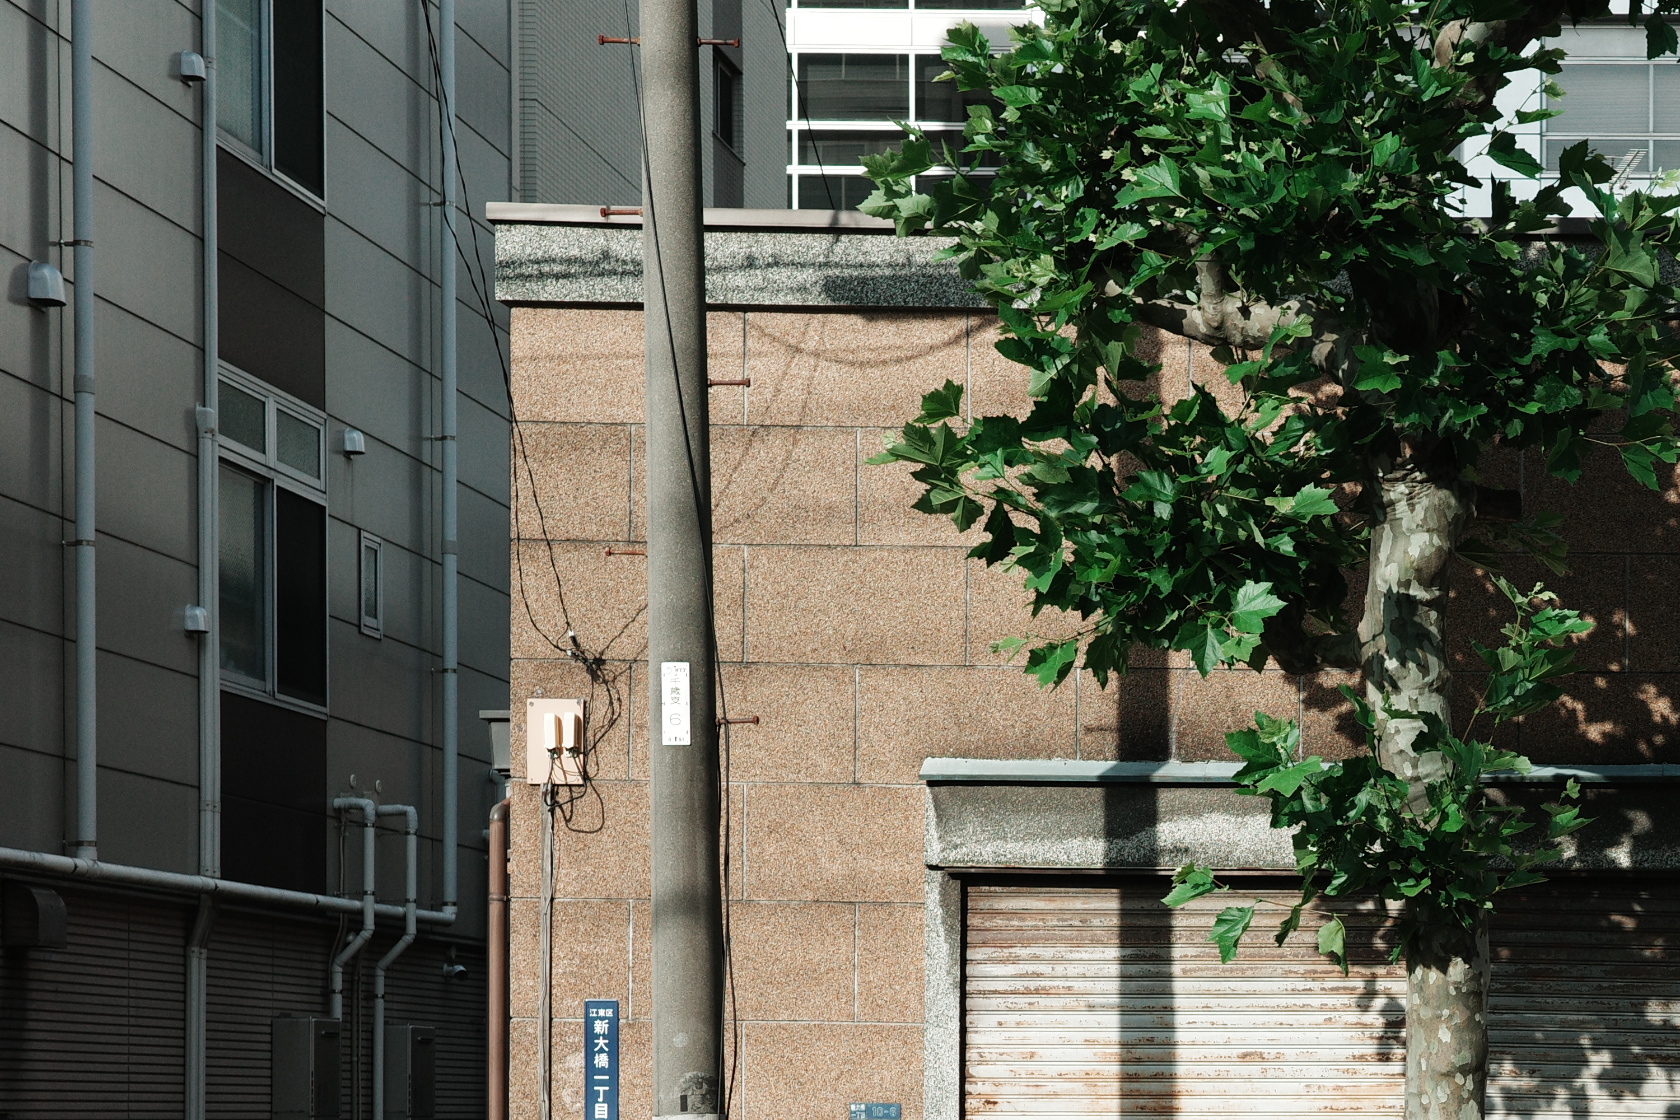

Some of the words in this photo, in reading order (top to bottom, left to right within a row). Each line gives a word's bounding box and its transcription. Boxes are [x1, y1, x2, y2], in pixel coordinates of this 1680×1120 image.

[669, 712, 682, 726] 6
[589, 1008, 613, 1017] 江東区
[593, 1019, 610, 1120] 新大橋一丁目
